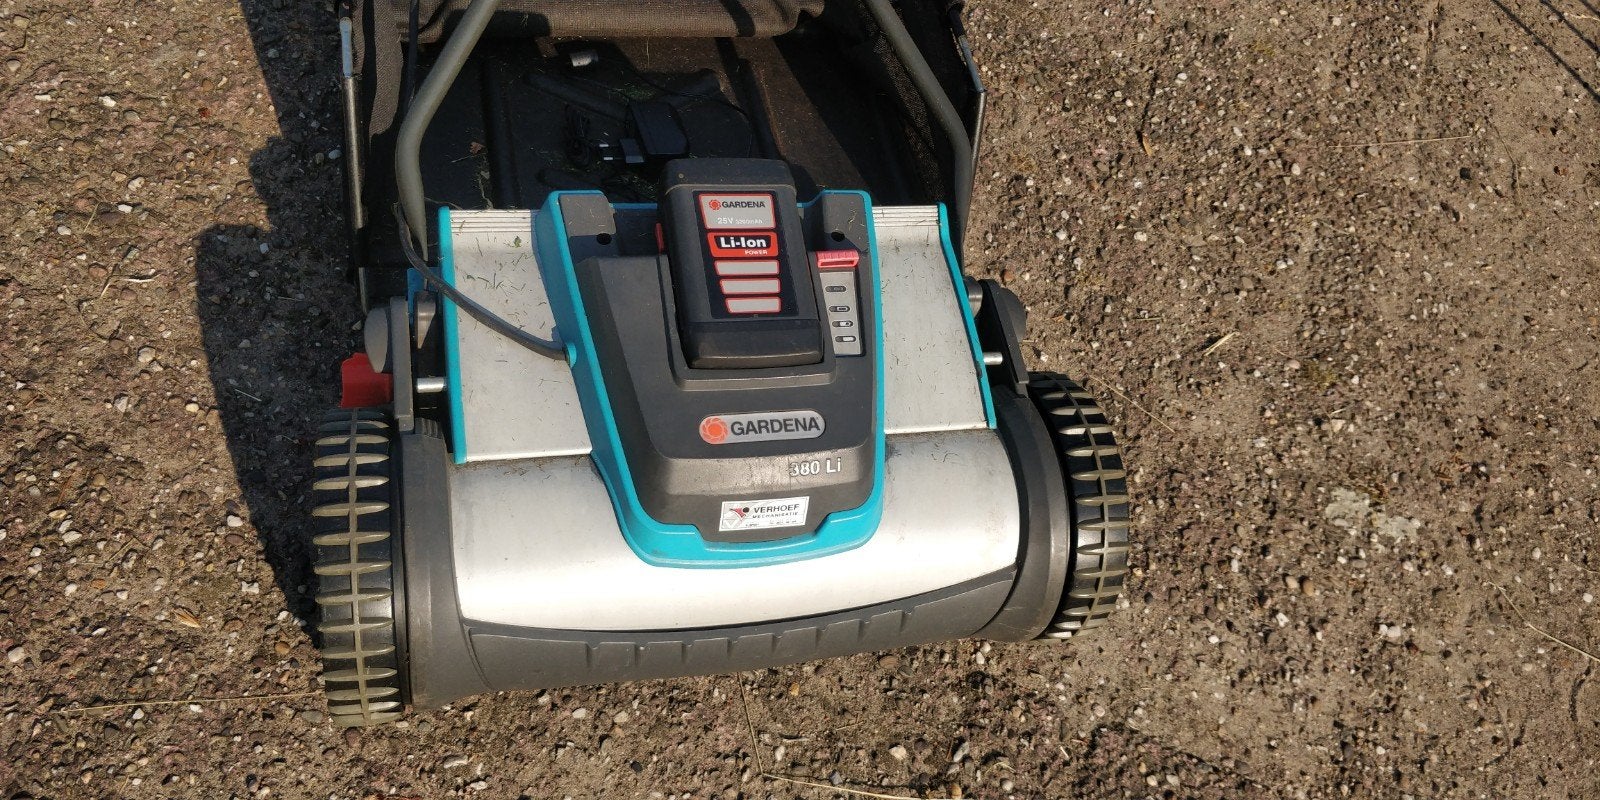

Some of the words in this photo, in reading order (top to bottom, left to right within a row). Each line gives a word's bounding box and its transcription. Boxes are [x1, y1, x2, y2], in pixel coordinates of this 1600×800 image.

[717, 217, 733, 225] 25V
[720, 237, 767, 248] Li-Ion
[730, 417, 820, 436] GARDENA
[789, 461, 820, 477] 380
[826, 457, 842, 474] Li
[753, 504, 800, 513] VERHOEF
